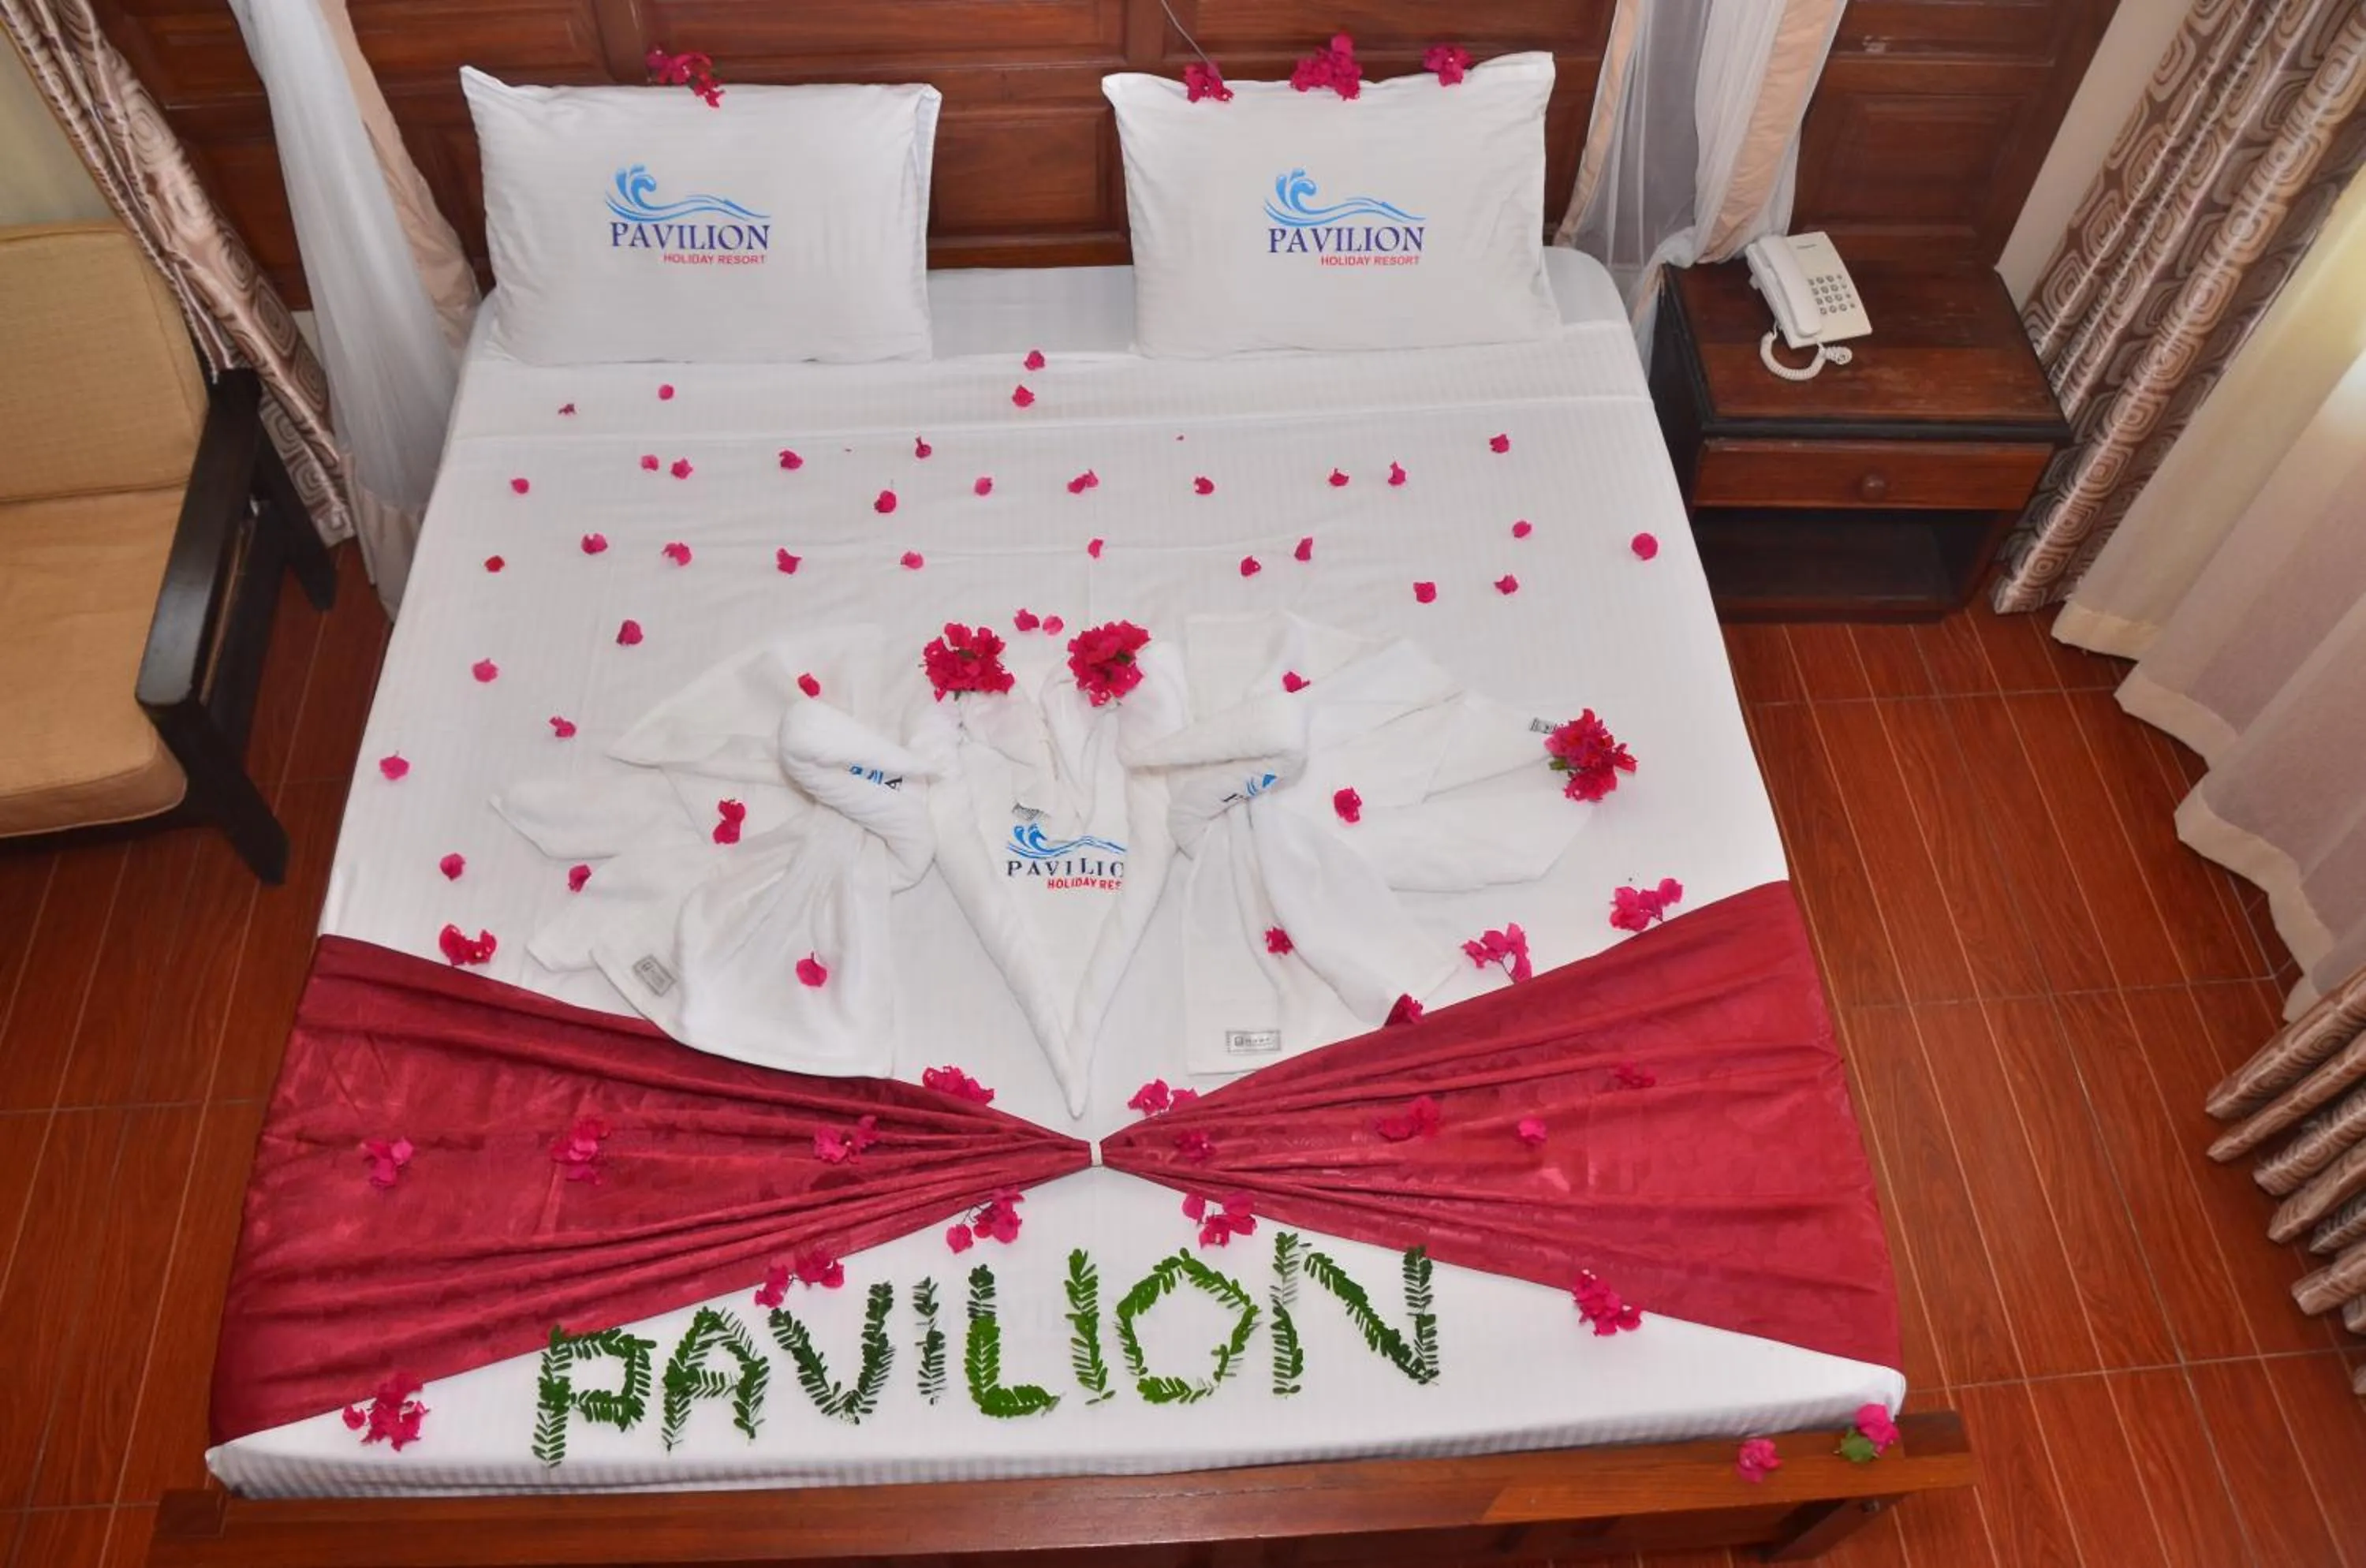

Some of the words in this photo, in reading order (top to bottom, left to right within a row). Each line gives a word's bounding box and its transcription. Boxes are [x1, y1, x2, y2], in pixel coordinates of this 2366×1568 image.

[610, 222, 771, 251] PAVILION
[1268, 226, 1425, 253] PAVILION
[663, 252, 713, 264] HOLIDAY
[717, 254, 765, 266] RESORT
[1320, 255, 1370, 267] HOLIDAY
[1373, 255, 1420, 267] RESORT
[1047, 876, 1096, 890] HOLIDAY
[532, 1232, 1440, 1468] PAVILION
